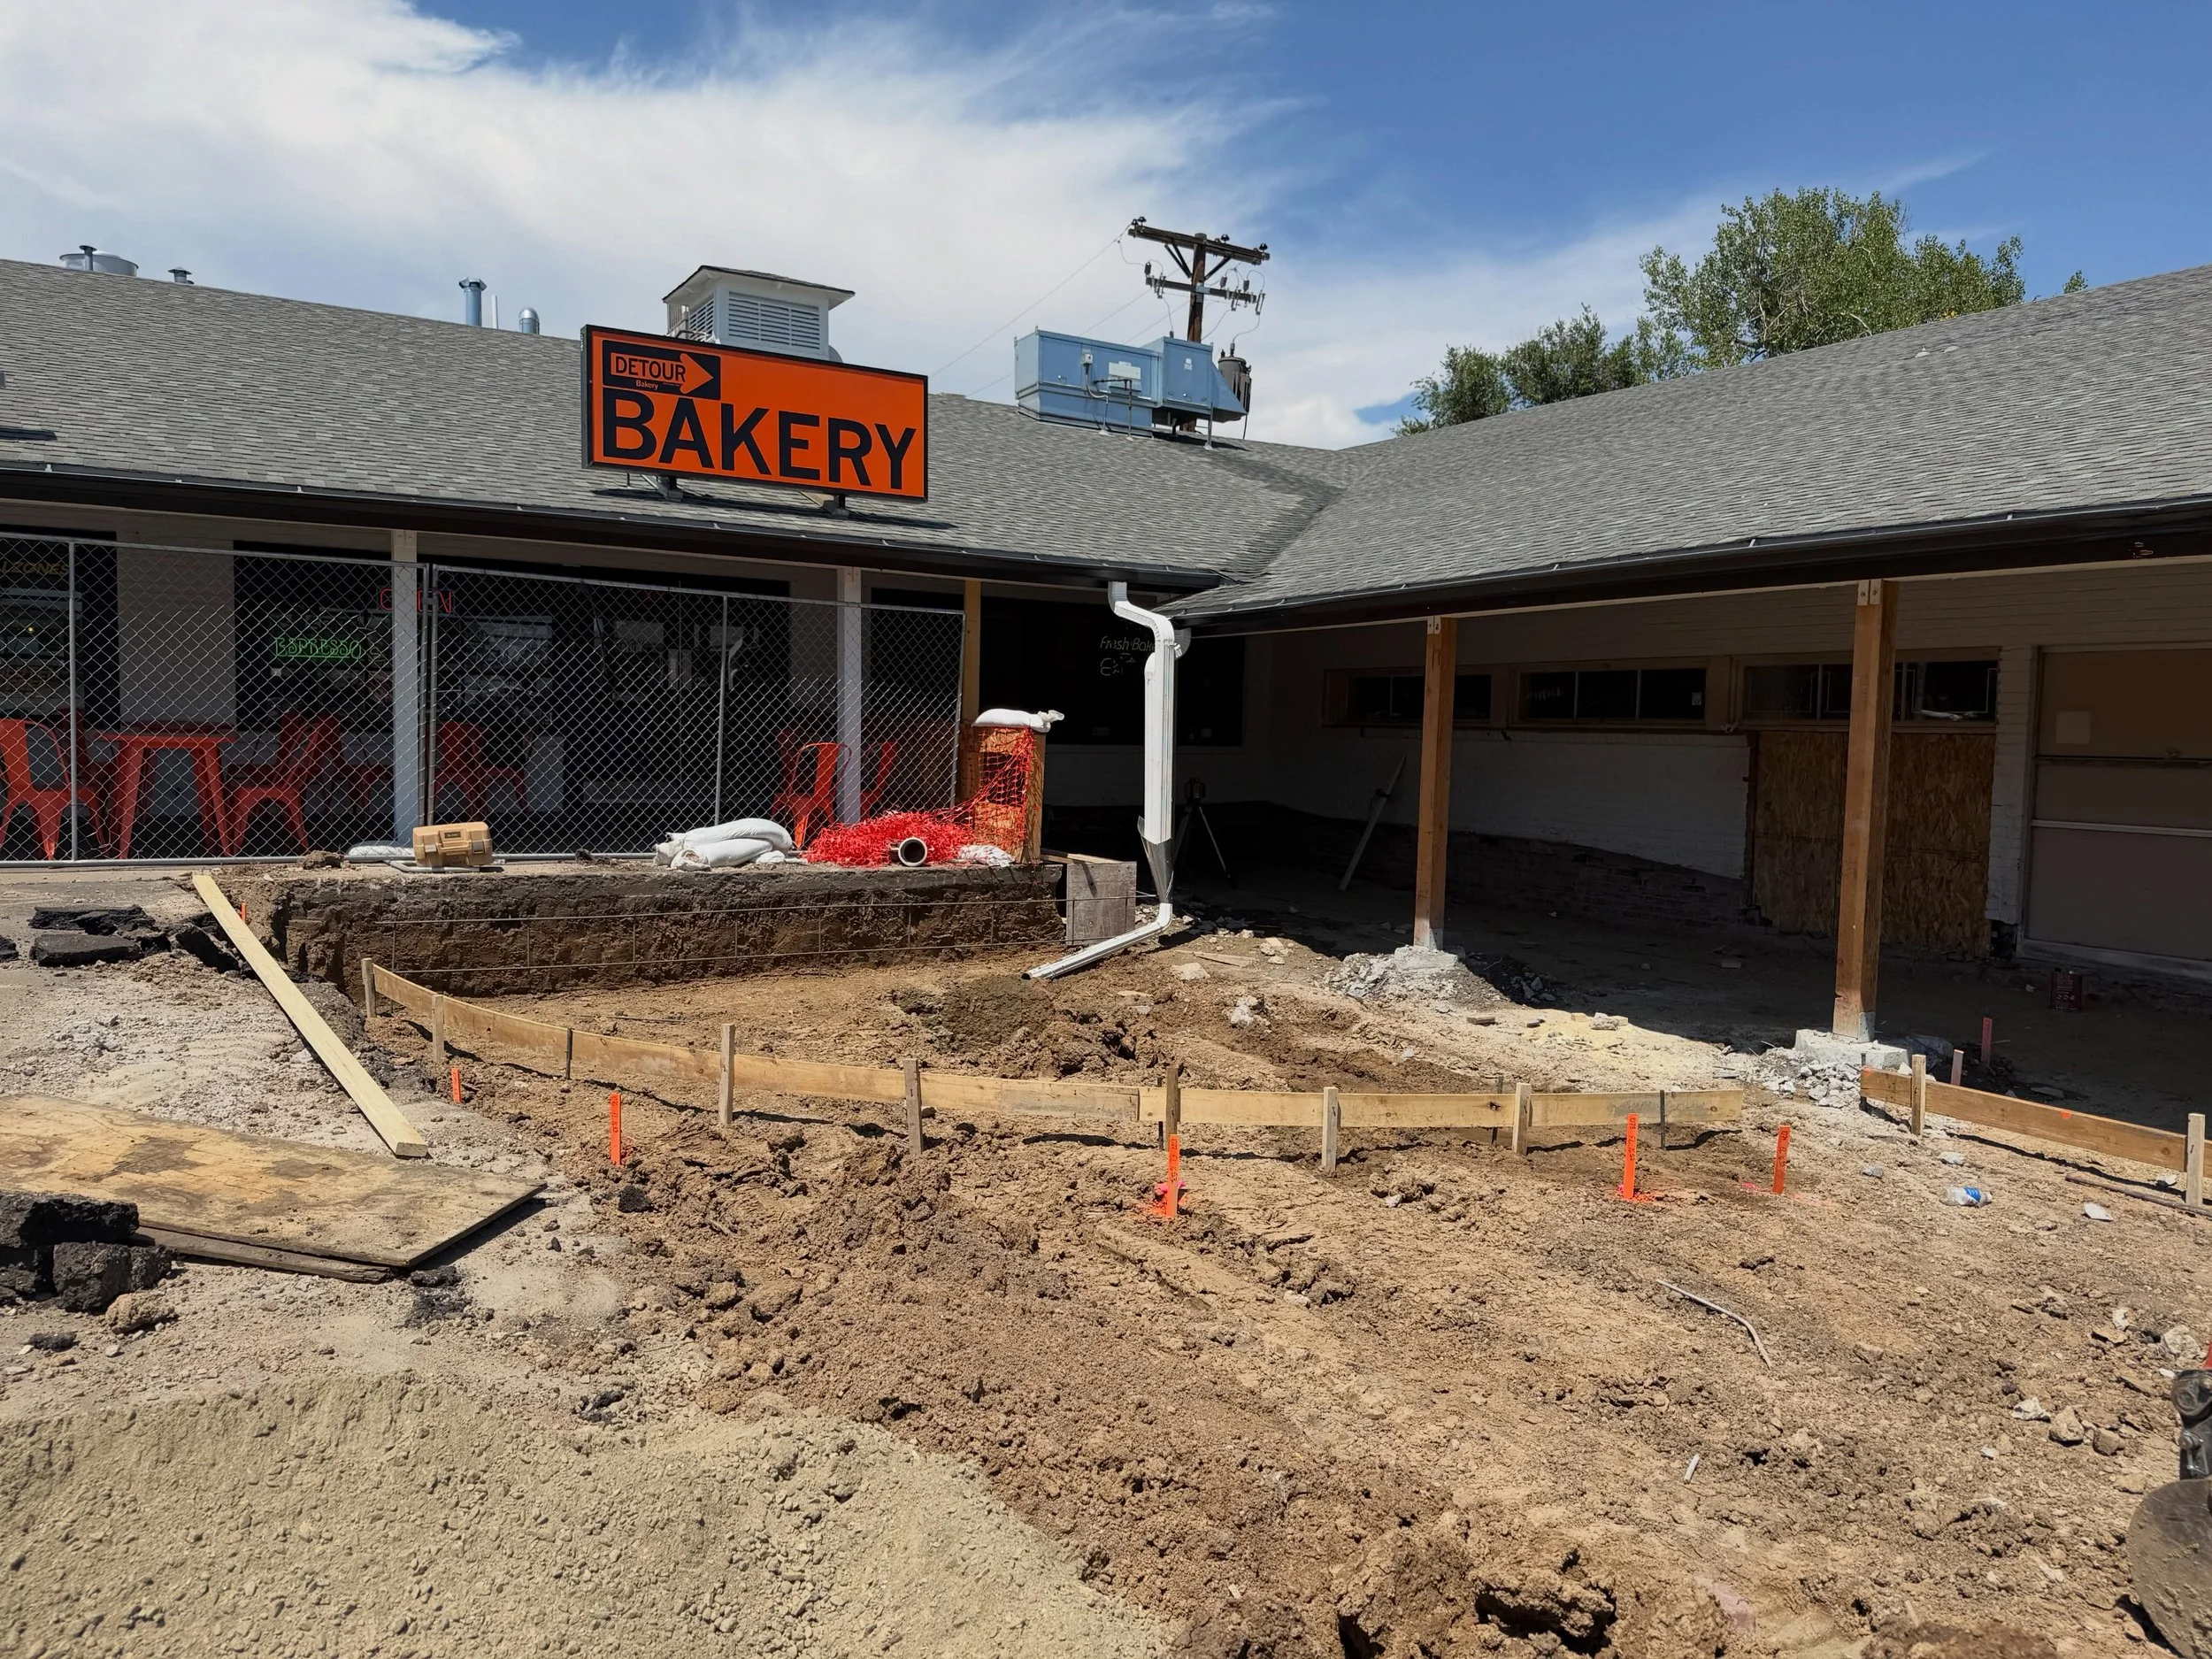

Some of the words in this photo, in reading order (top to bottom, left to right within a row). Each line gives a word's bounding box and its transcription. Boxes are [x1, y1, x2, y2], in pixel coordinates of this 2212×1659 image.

[615, 356, 686, 382] DETOUR
[635, 380, 659, 390] Bakery
[603, 391, 917, 490] BAKERY
[0, 559, 69, 575] LZONES
[378, 586, 454, 614] OEN
[275, 635, 362, 660] ESPRESSO
